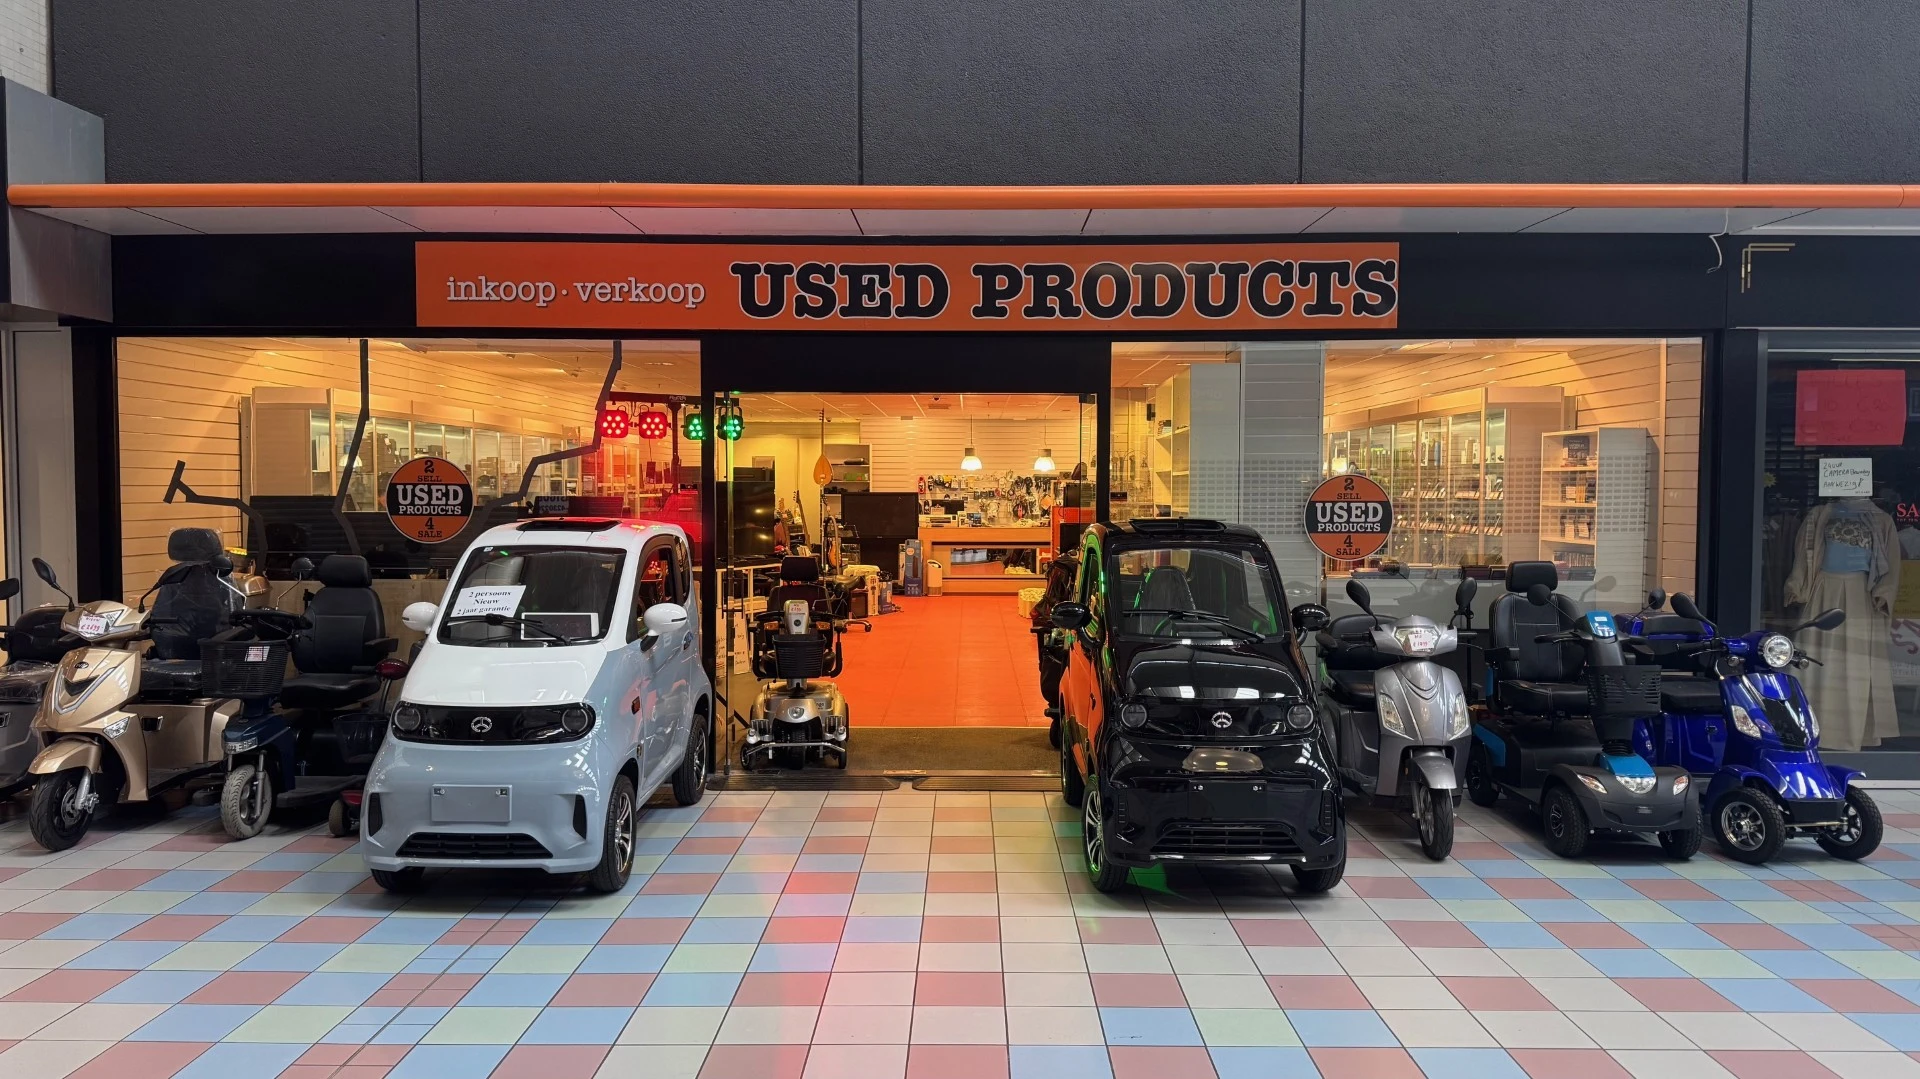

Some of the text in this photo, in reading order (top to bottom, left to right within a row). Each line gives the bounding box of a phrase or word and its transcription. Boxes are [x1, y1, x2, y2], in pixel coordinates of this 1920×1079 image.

[446, 258, 1398, 319] inkoop verkoop USED PRODUCTS
[424, 459, 435, 474] 2
[1344, 477, 1355, 491] 2
[396, 484, 464, 505] USED
[398, 505, 462, 515] PRODUCTS
[1315, 501, 1383, 523] USED
[424, 517, 434, 530] 4
[1317, 523, 1381, 532] PRODUCTS
[417, 530, 442, 538] SALE
[1343, 534, 1353, 547] 4
[1336, 548, 1361, 556] SALE
[479, 605, 511, 613] garantie
